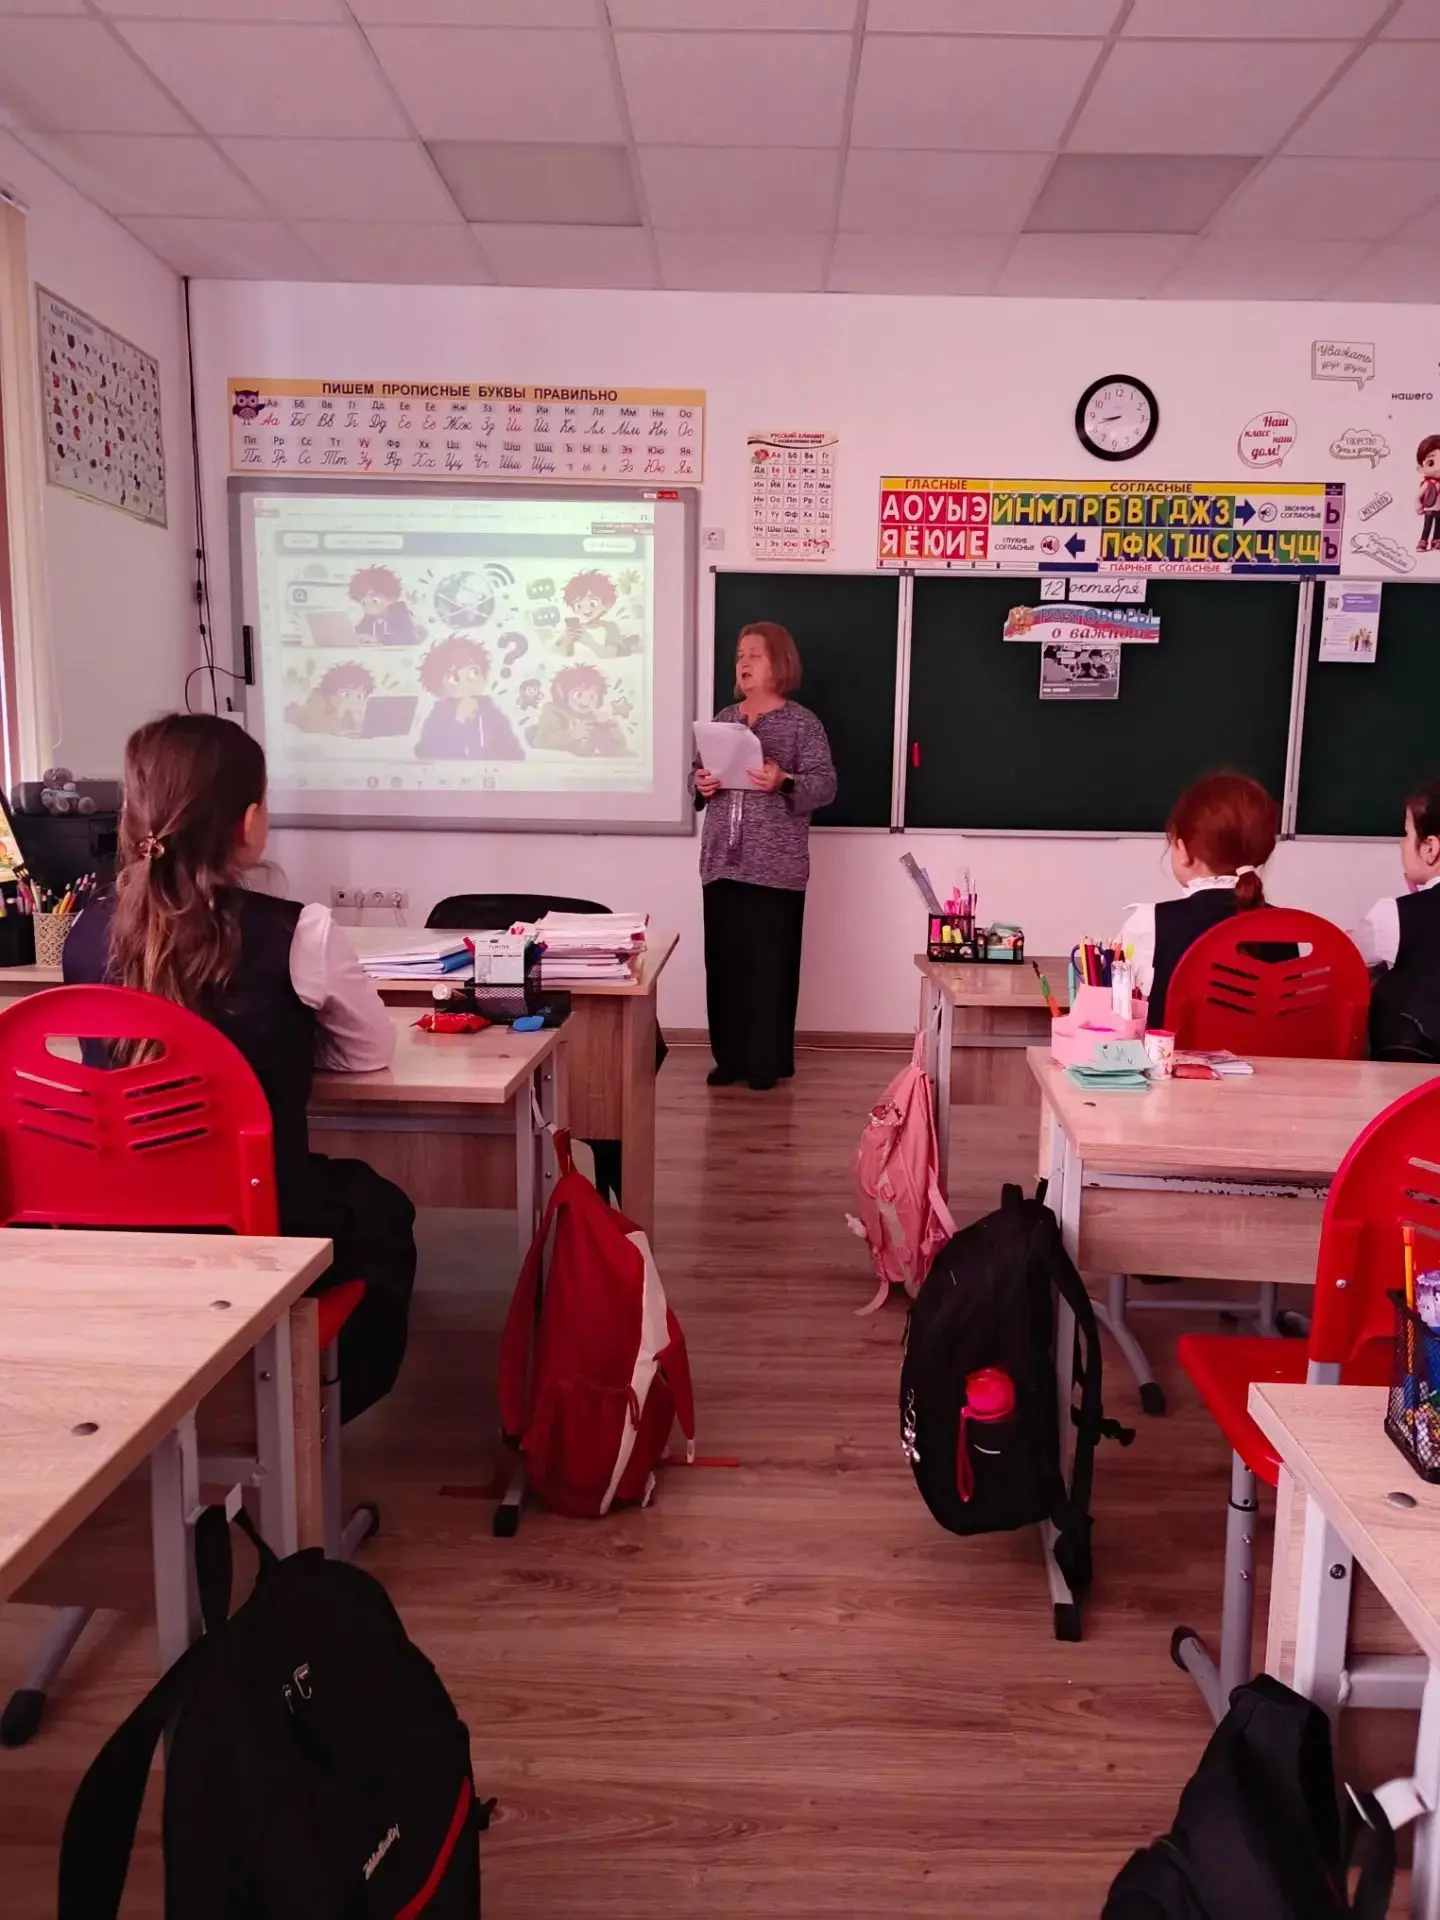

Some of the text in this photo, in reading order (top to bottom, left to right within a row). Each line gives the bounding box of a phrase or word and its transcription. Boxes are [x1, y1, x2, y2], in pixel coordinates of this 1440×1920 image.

[1318, 344, 1372, 363] Уважать
[322, 383, 618, 401] ПИШЕМ ПРОПИСНЫЕ БУКВЫ ПРАВИЛЬНО
[1104, 392, 1111, 400] 11
[1116, 388, 1124, 397] 12
[1392, 392, 1433, 400] нашего
[1095, 400, 1103, 408] 10
[1263, 416, 1289, 427] Наш
[1252, 444, 1280, 460] дом!
[905, 480, 1192, 493] ГЛАСНЫЕ СОГЛАСНЫЕ
[1110, 564, 1220, 572] ПАРНЫЕ СОГЛАСНЫЕ
[1044, 581, 1064, 596] 12
[1040, 608, 1153, 624] РАЗГОВОРЫ
[1052, 628, 1061, 638] о
